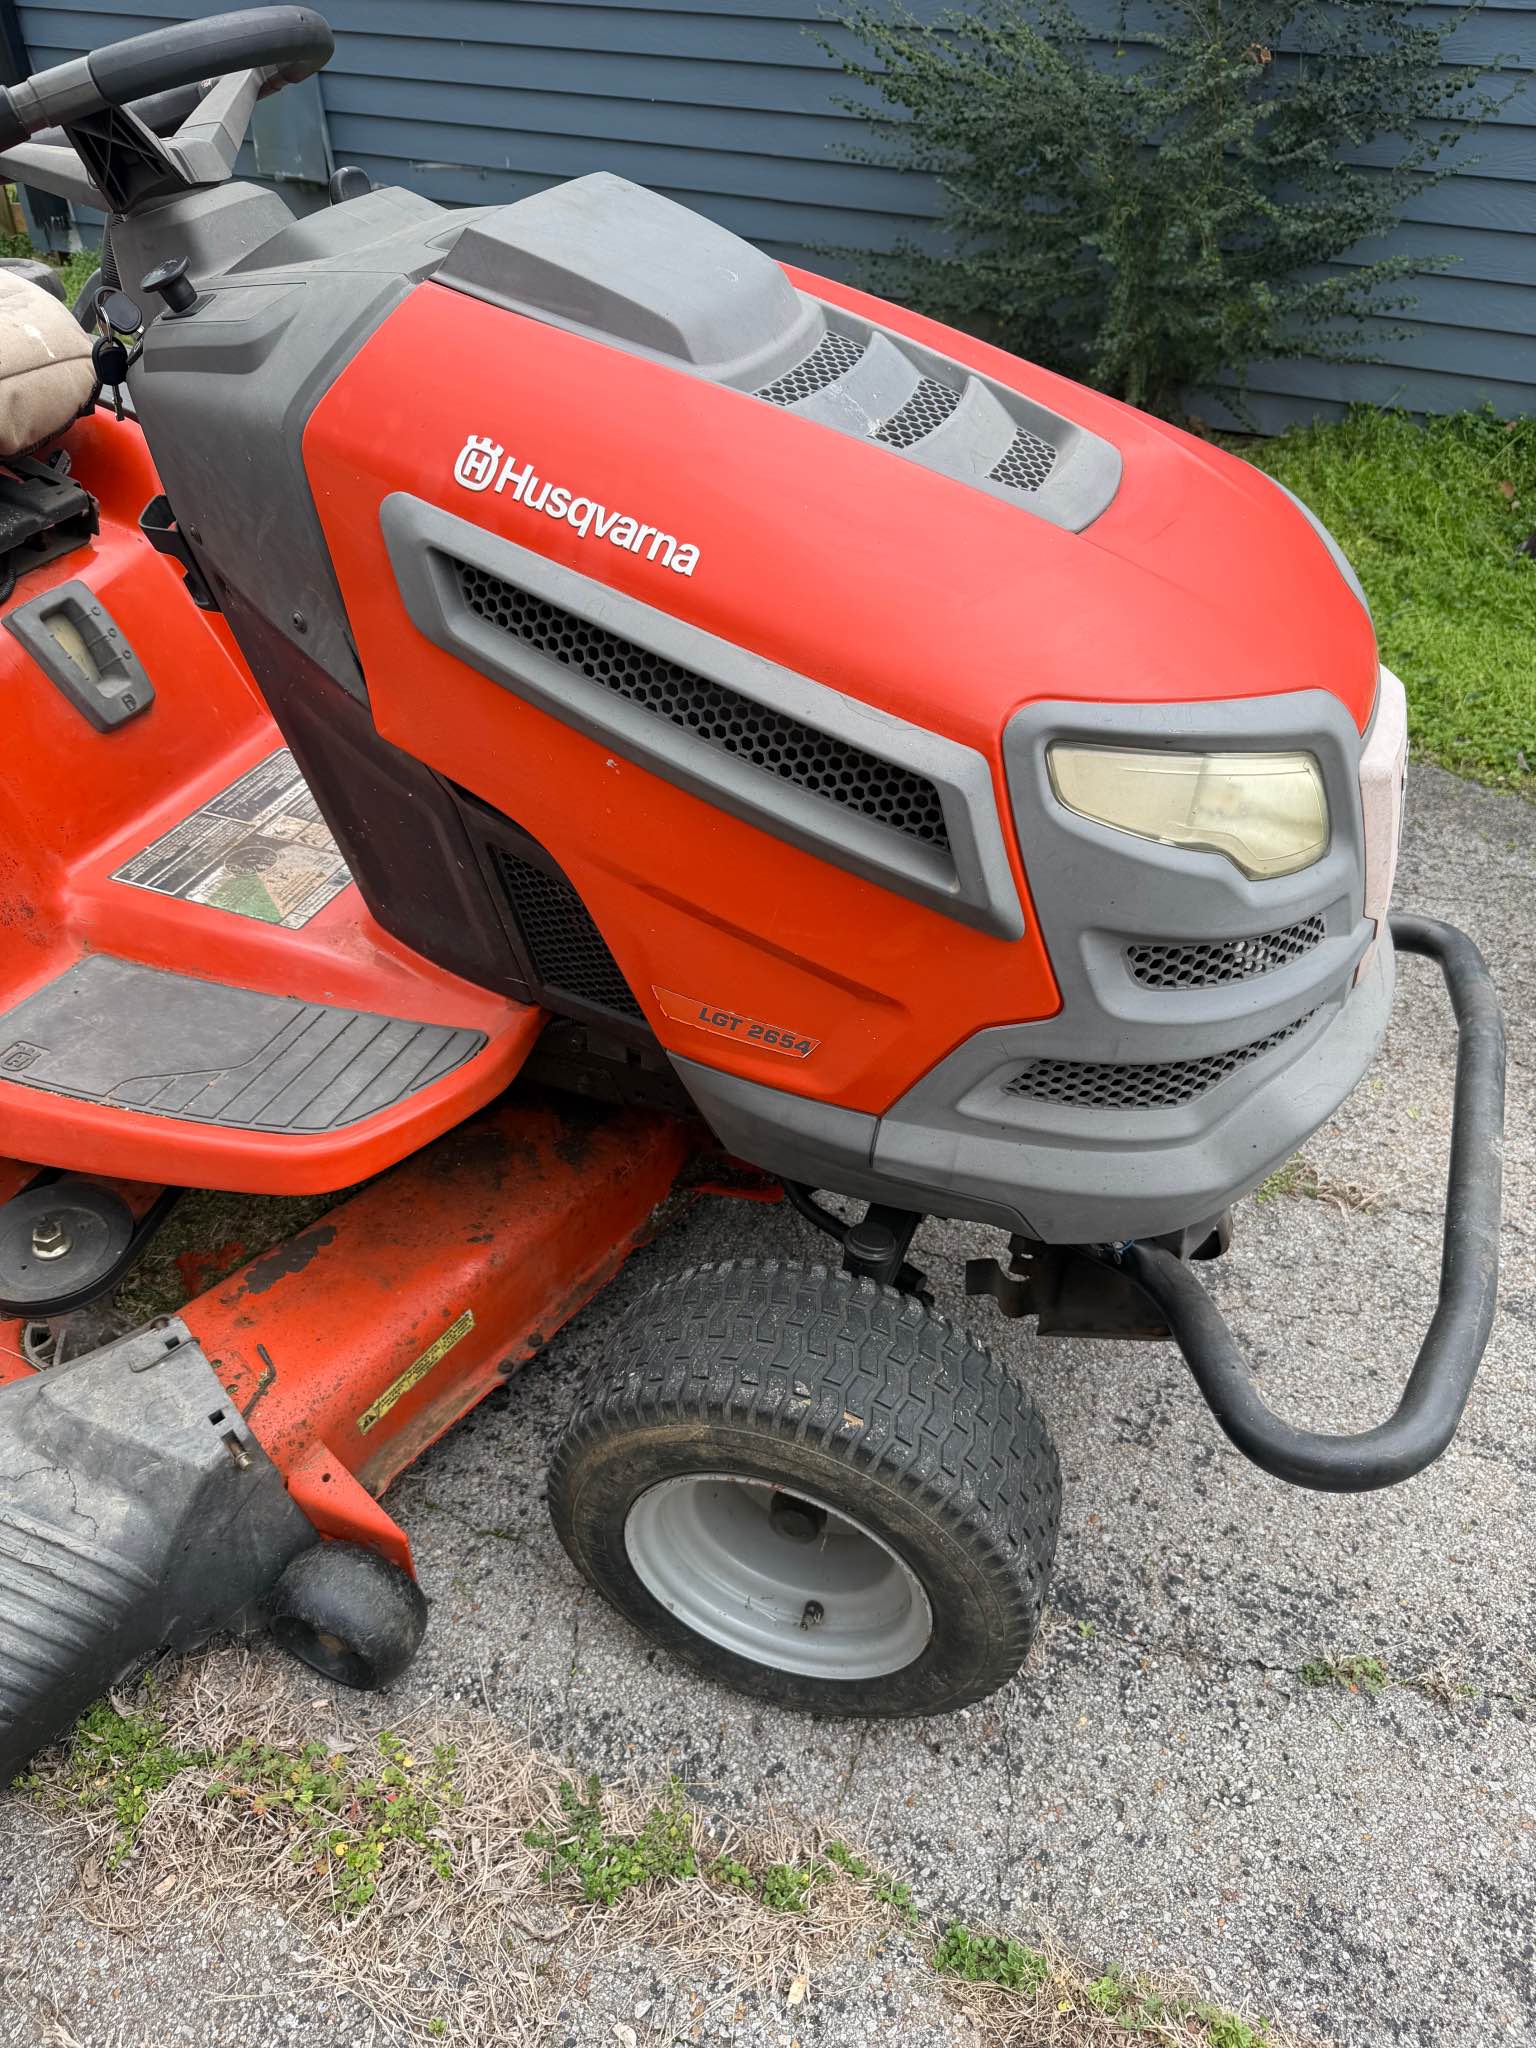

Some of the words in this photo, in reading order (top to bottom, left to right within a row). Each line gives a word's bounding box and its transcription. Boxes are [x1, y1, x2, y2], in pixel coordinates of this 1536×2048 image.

[494, 456, 700, 577] Husqvarna
[698, 1007, 743, 1031] LGT
[747, 1024, 812, 1053] 2654
